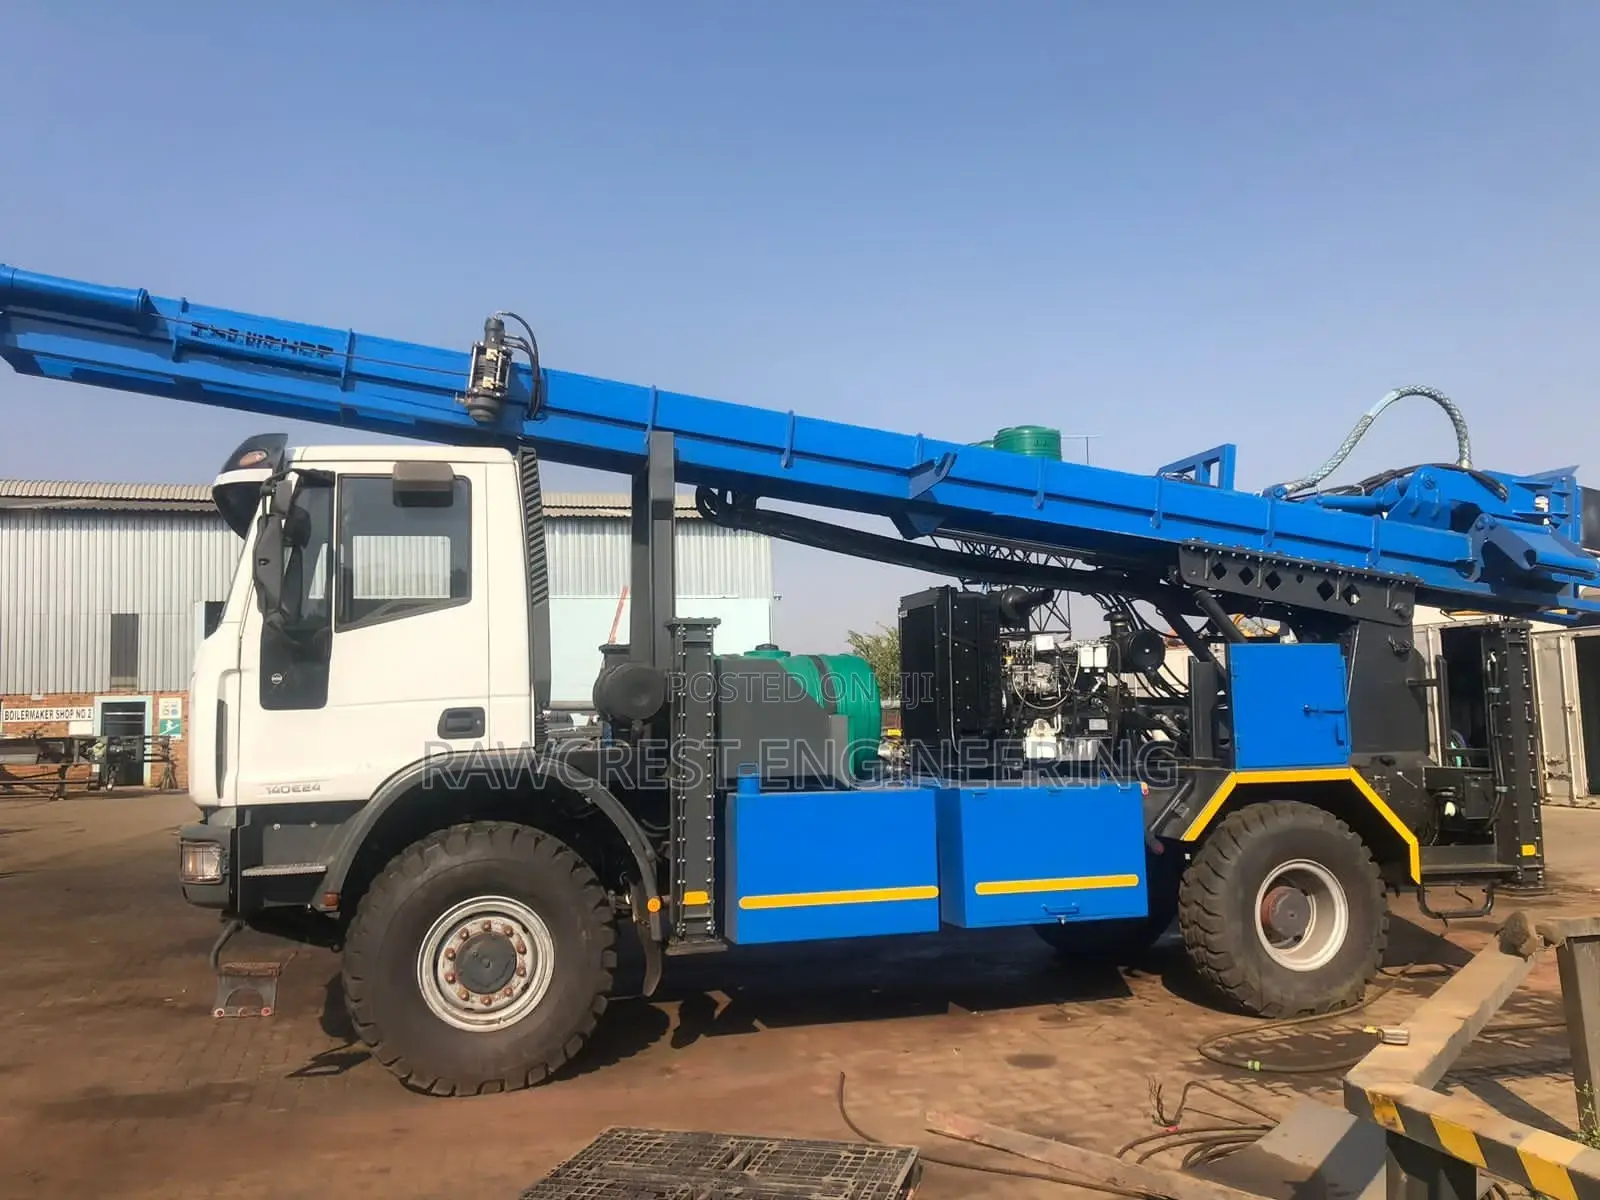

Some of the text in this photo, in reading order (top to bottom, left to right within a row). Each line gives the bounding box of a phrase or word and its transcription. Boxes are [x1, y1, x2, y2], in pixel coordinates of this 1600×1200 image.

[4, 710, 54, 720] BOILERMAKER
[55, 709, 74, 719] SHOP
[265, 784, 321, 795] 140E24
